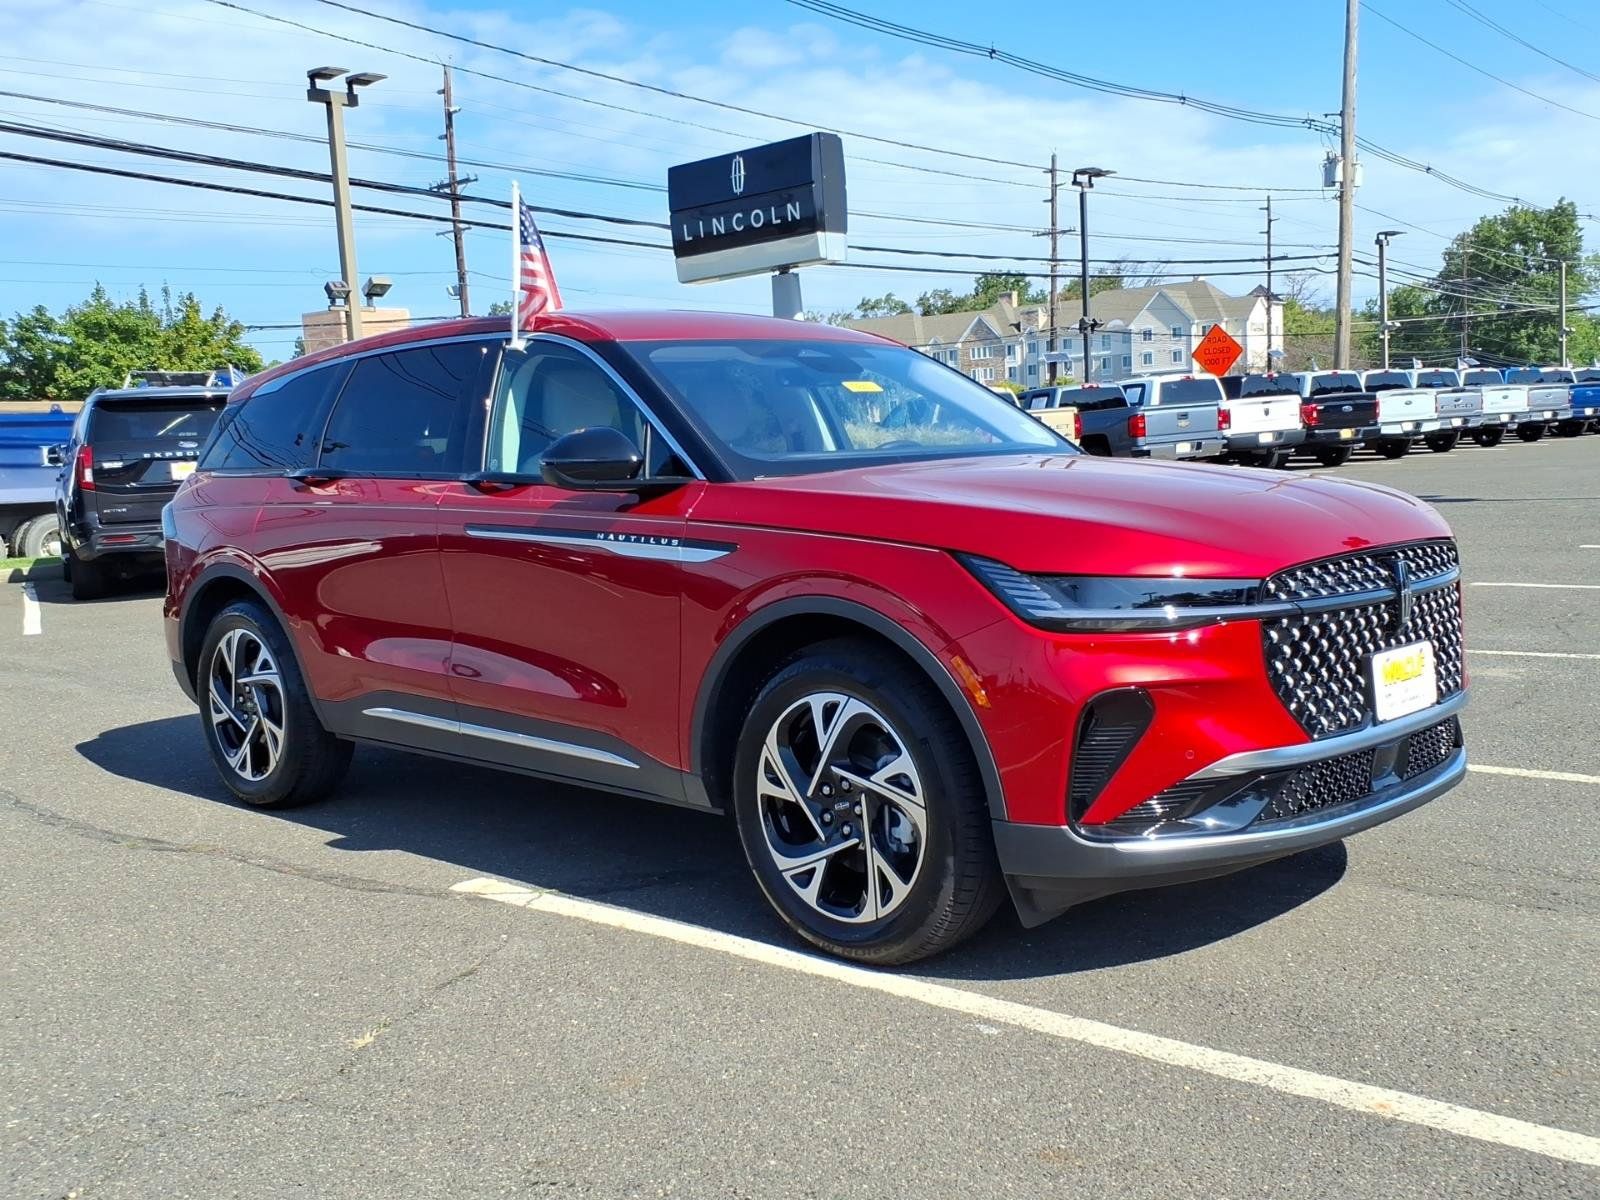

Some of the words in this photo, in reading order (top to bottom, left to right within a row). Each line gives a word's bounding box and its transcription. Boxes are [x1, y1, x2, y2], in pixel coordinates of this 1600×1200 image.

[683, 201, 801, 242] LINCOLN
[1206, 335, 1228, 344] ROAD
[1204, 346, 1231, 356] CLOSED
[596, 533, 679, 546] NAUTILUS
